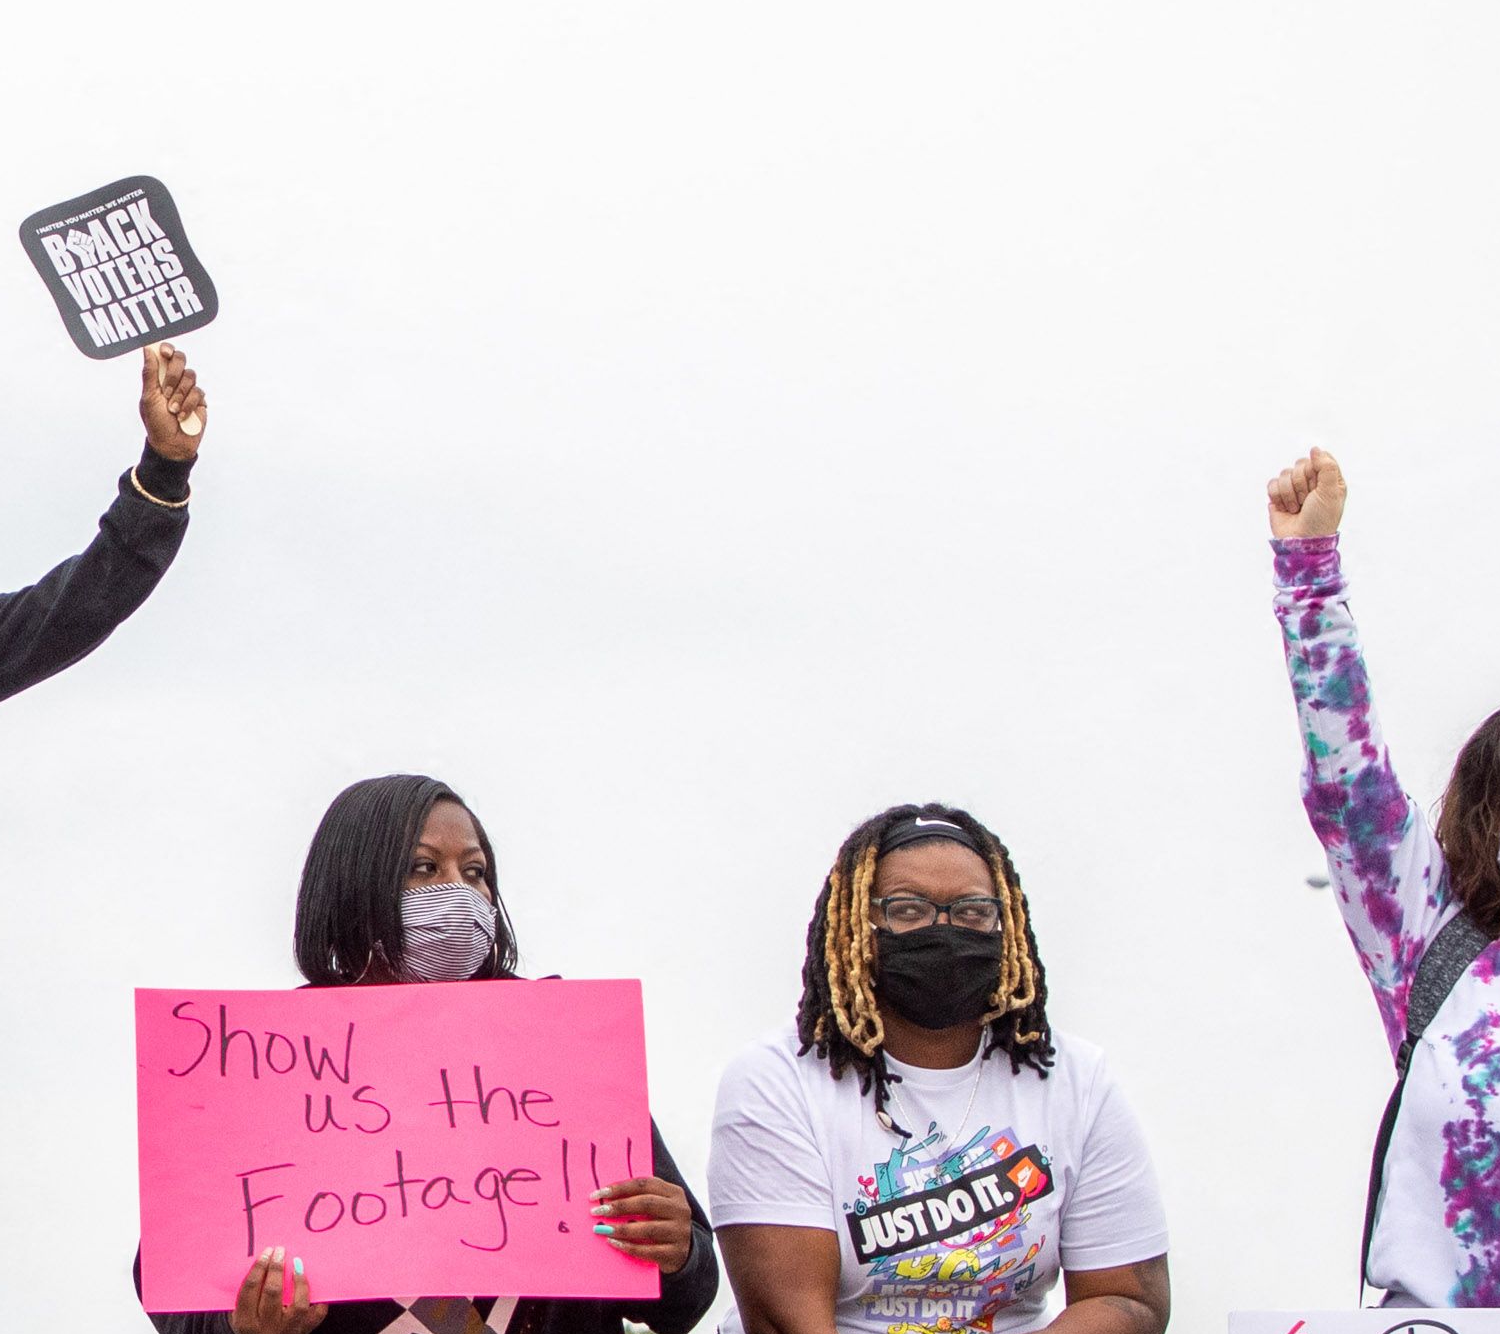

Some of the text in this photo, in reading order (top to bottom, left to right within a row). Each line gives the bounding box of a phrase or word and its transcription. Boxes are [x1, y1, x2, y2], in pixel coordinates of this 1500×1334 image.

[61, 238, 184, 310] VOTERS
[80, 276, 203, 347] MATTER
[167, 1001, 354, 1084] Show
[304, 1065, 561, 1133] us the
[860, 1202, 928, 1254] JUST
[926, 1189, 975, 1231] DO
[971, 1174, 1014, 1212] IT.
[871, 1297, 918, 1317] JUST
[922, 1299, 953, 1318] DO
